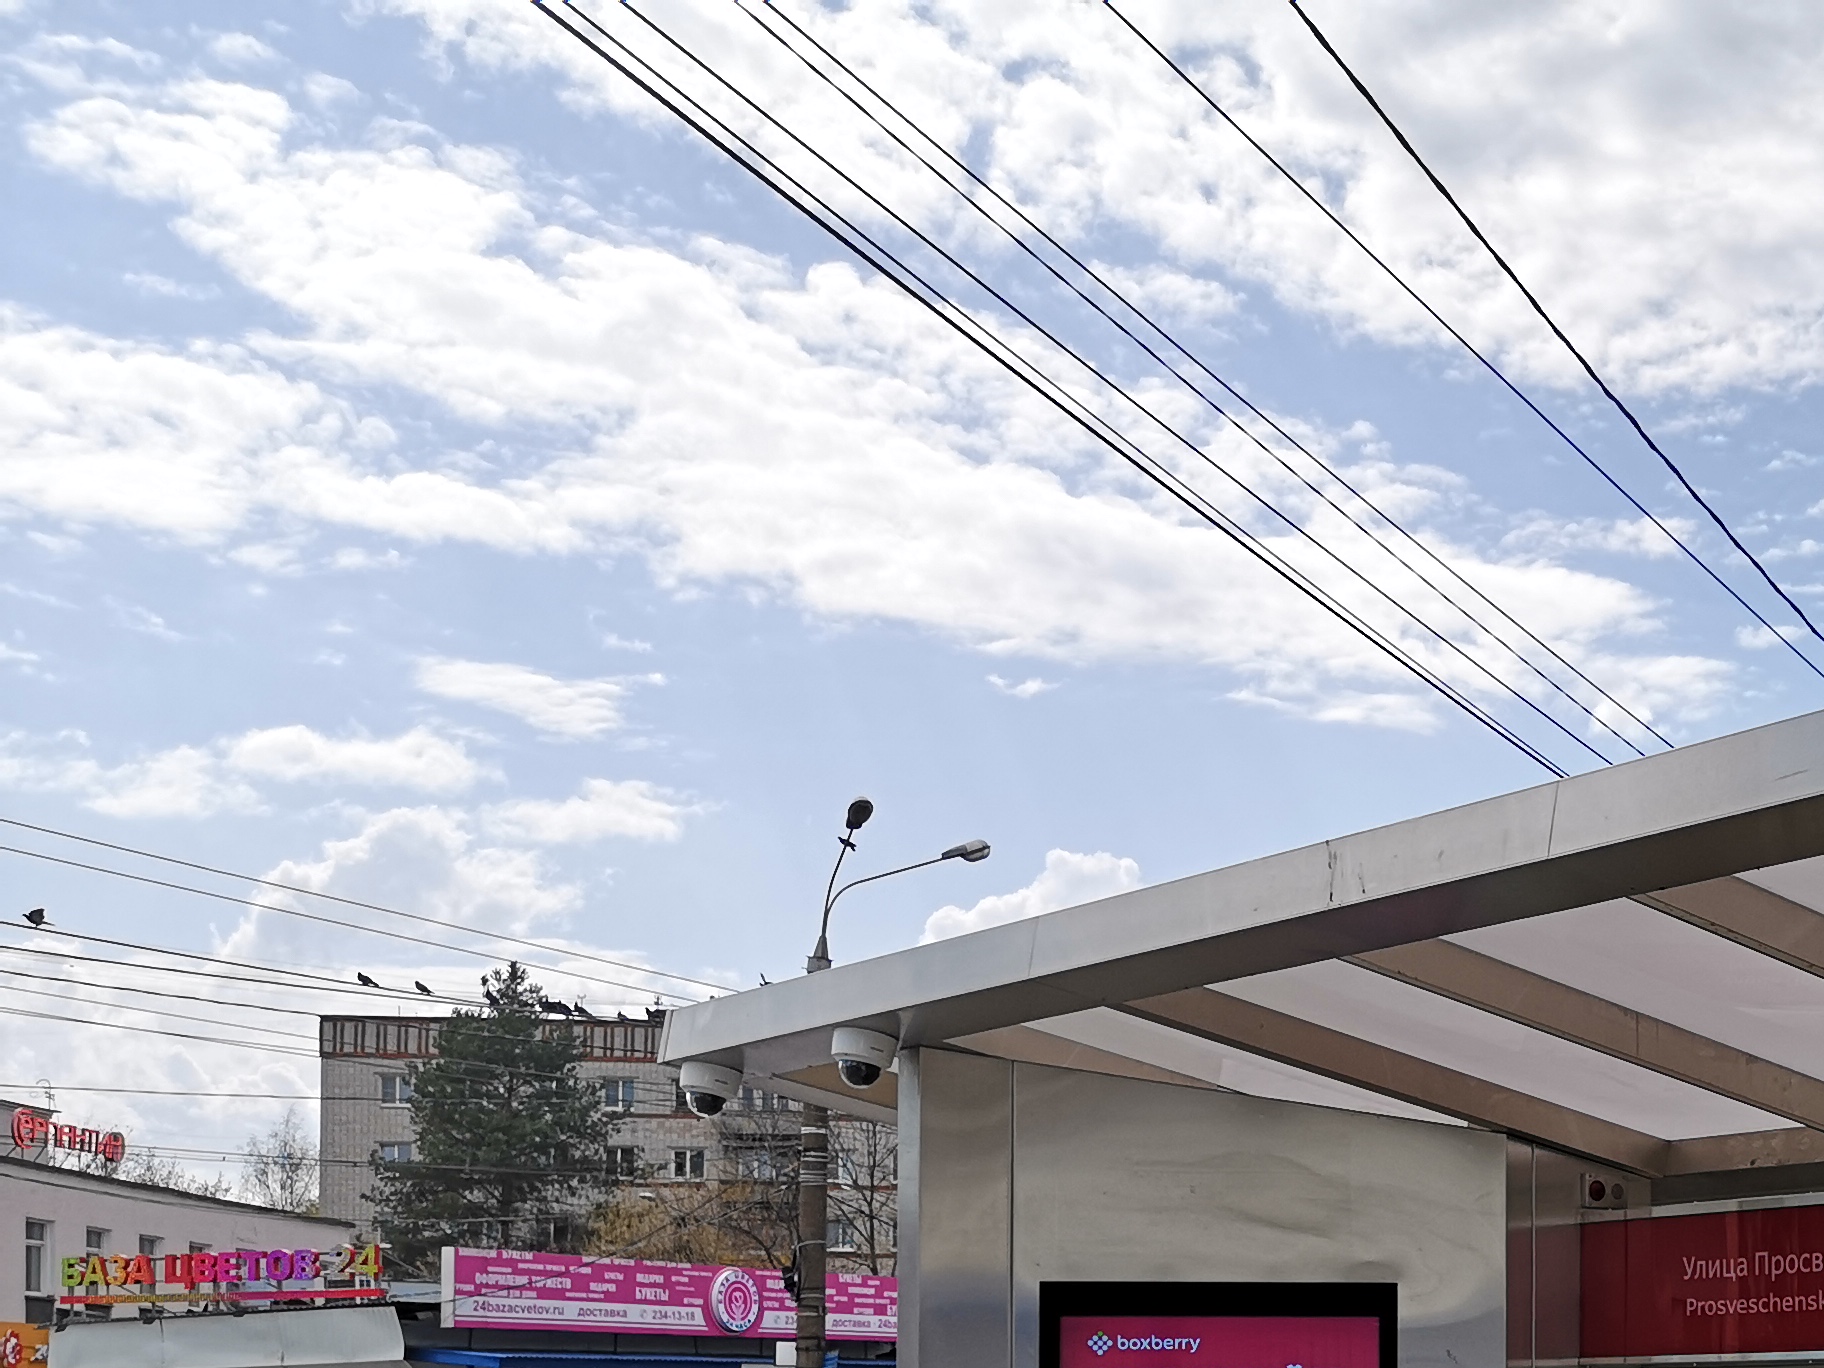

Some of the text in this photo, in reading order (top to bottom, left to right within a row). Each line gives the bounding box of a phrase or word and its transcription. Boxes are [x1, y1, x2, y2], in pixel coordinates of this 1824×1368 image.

[61, 1243, 384, 1290] БАЗА ЦВЕТОВ 24
[1682, 1256, 1748, 1281] Улица
[472, 1300, 565, 1316] 24bazacvetov.ru
[577, 1307, 628, 1318] доставка
[652, 1309, 696, 1321] 234-13-18
[832, 1318, 871, 1328] доставка
[1117, 1334, 1201, 1353] boxberry
